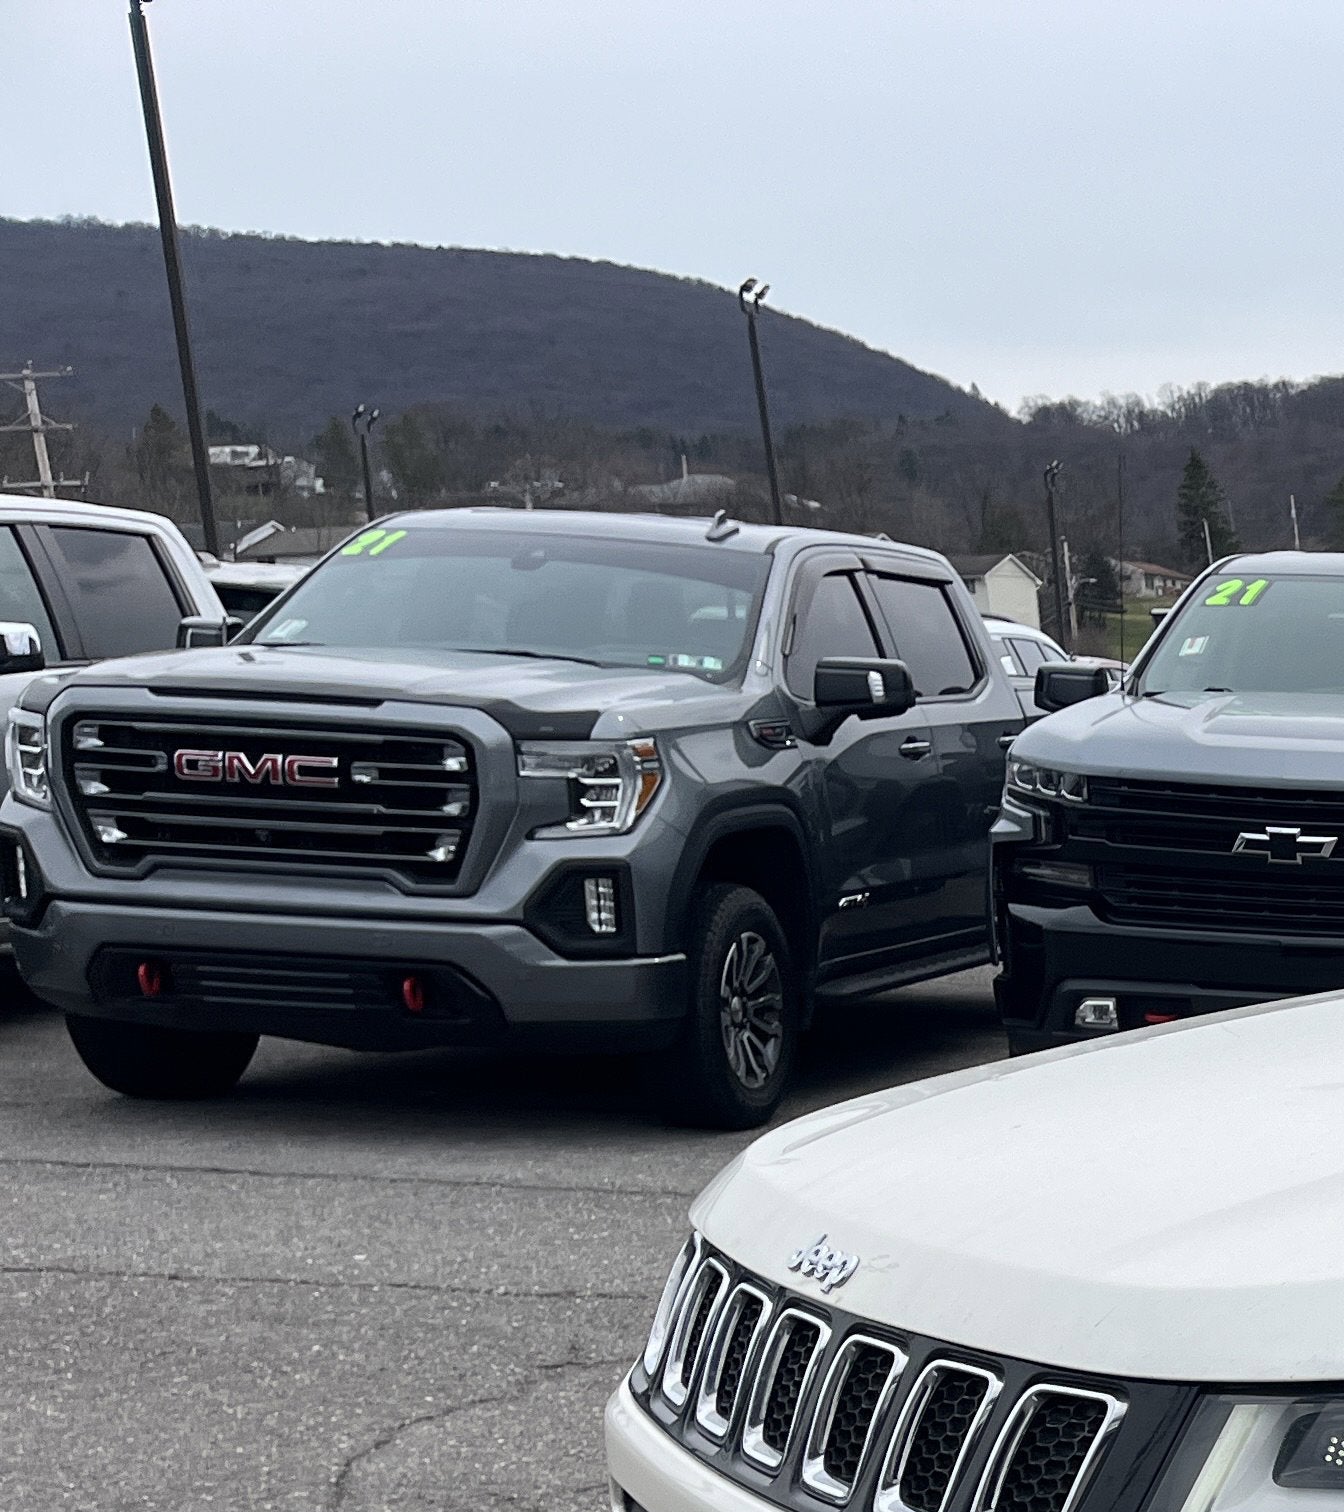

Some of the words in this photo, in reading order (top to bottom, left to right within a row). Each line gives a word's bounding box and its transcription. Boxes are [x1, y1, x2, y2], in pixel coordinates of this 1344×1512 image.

[1205, 578, 1268, 606] 21
[174, 749, 339, 788] GMC
[788, 1234, 860, 1294] Jeep
